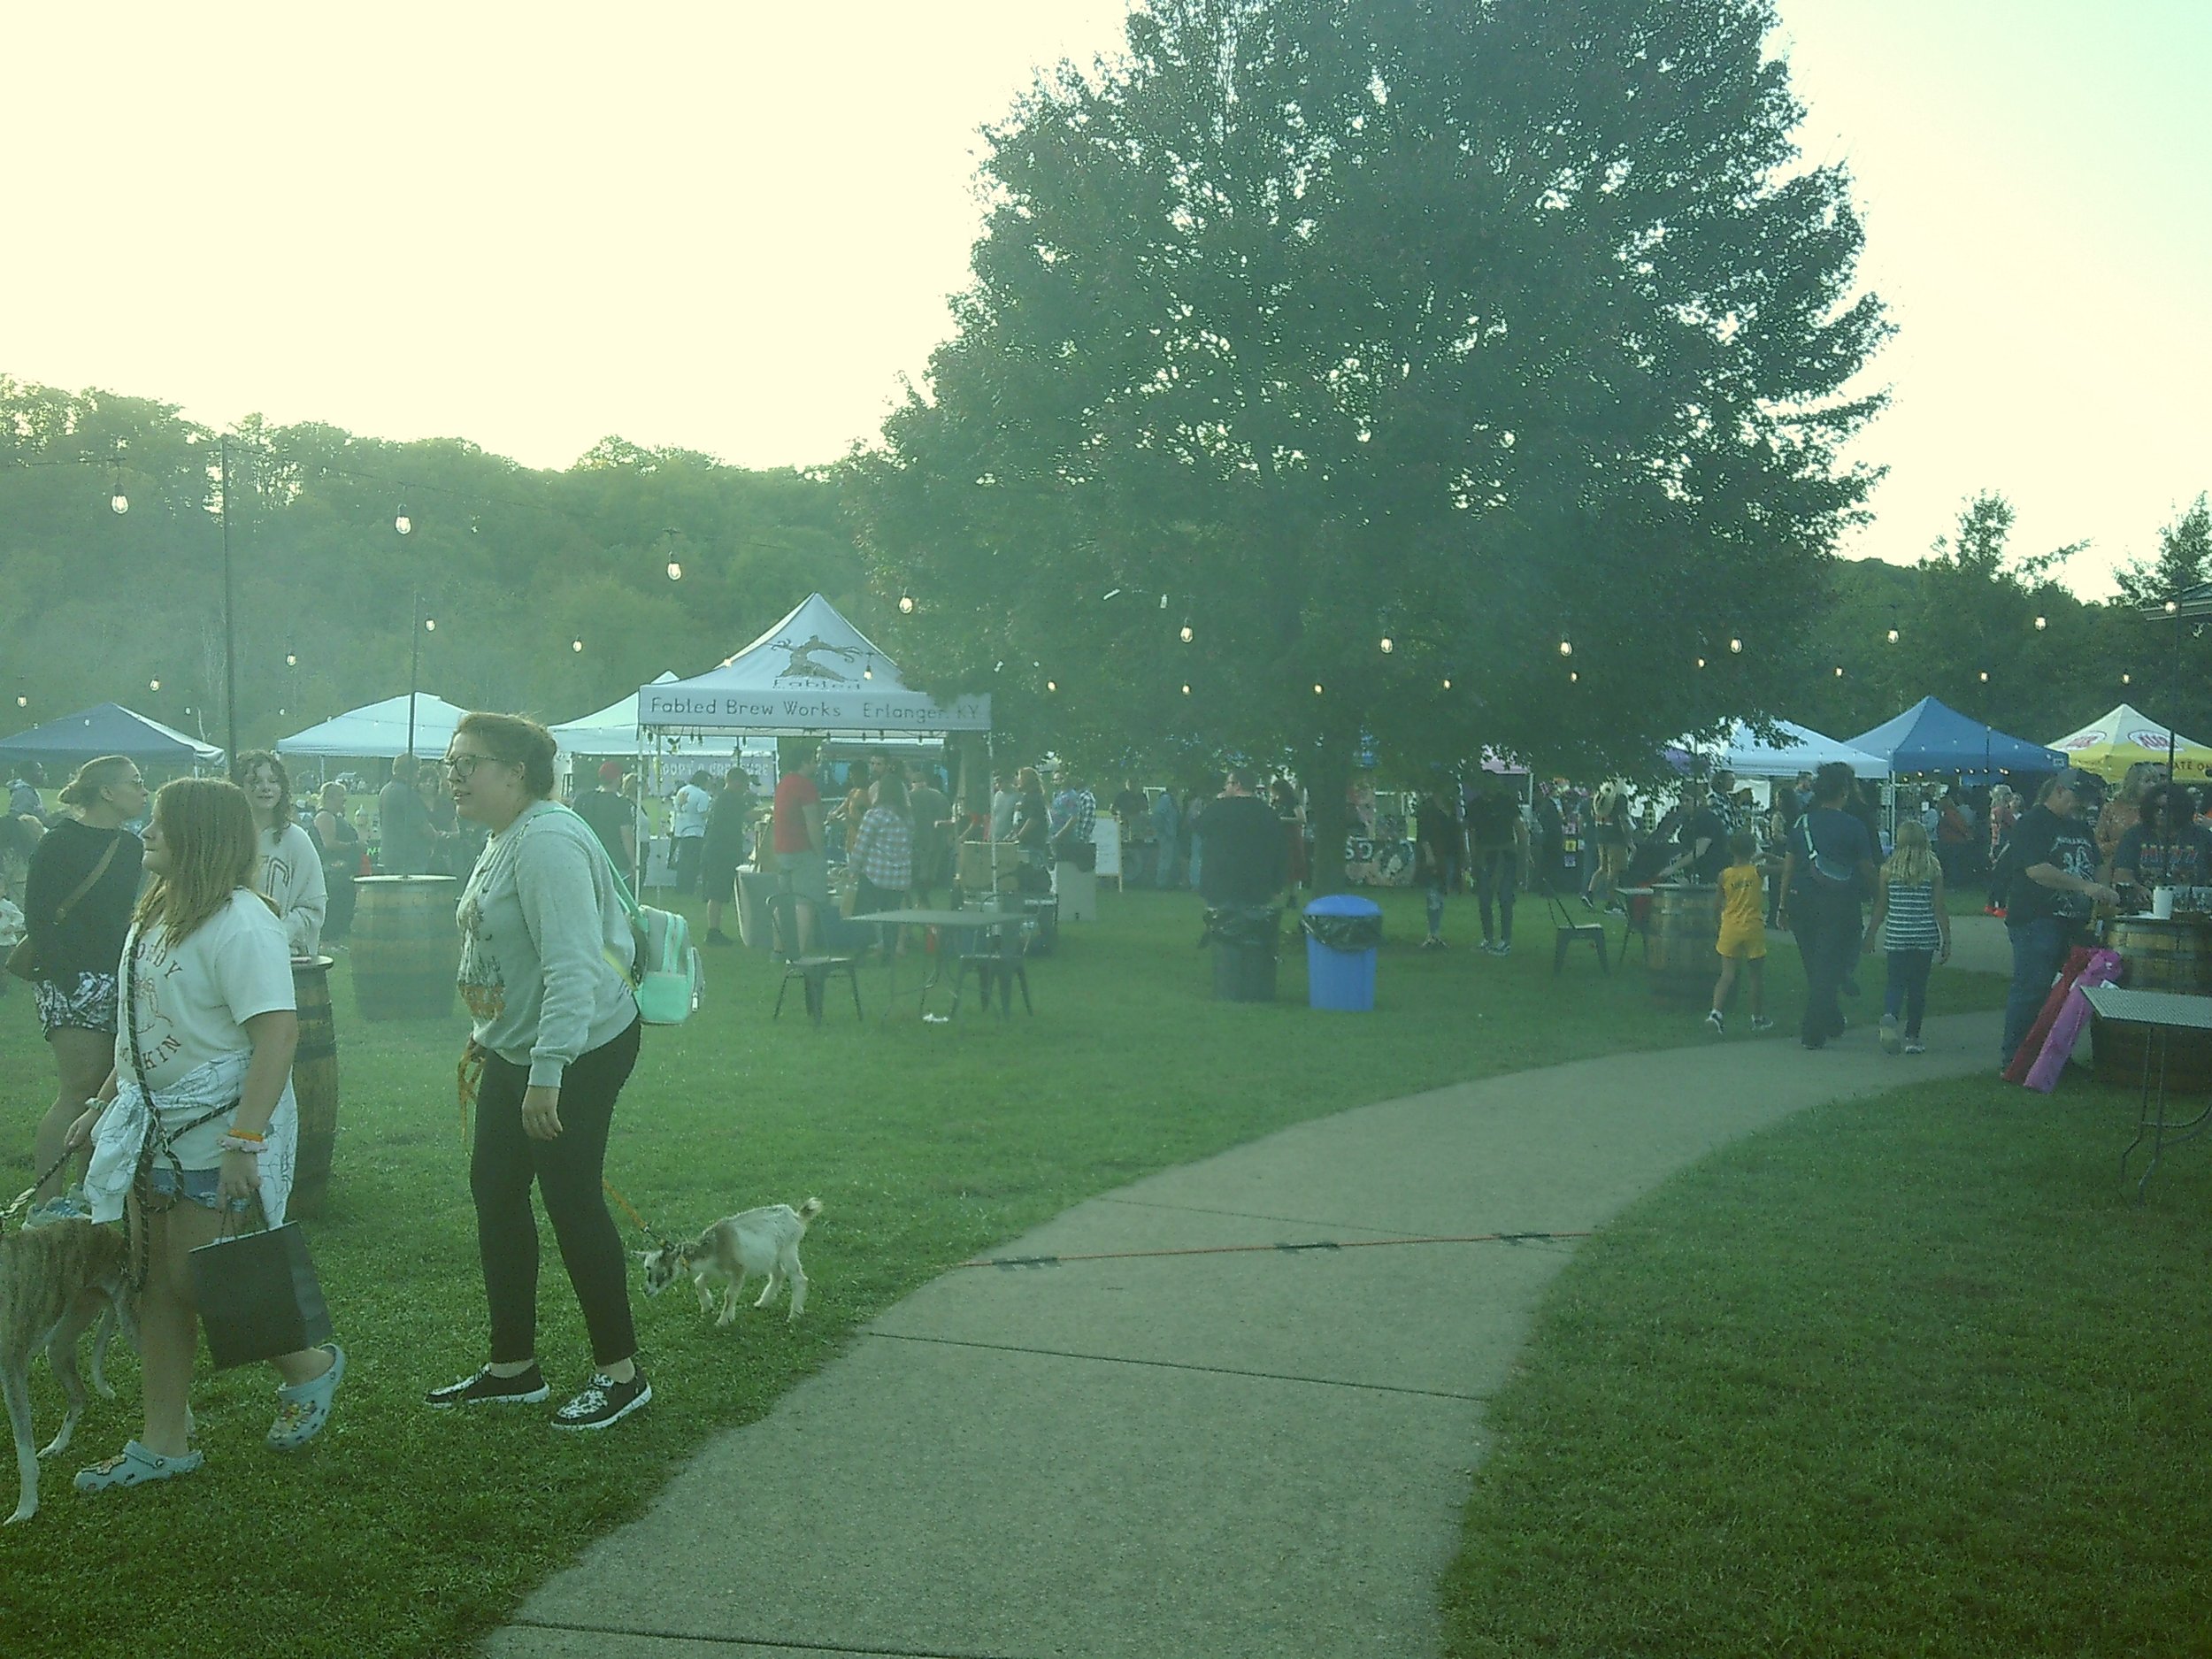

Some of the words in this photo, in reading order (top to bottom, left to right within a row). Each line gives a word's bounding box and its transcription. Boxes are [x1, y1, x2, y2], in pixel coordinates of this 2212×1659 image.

[651, 696, 718, 715] Fabled
[726, 699, 773, 715] Brew
[783, 700, 841, 718] Works
[659, 763, 693, 777] DOPT
